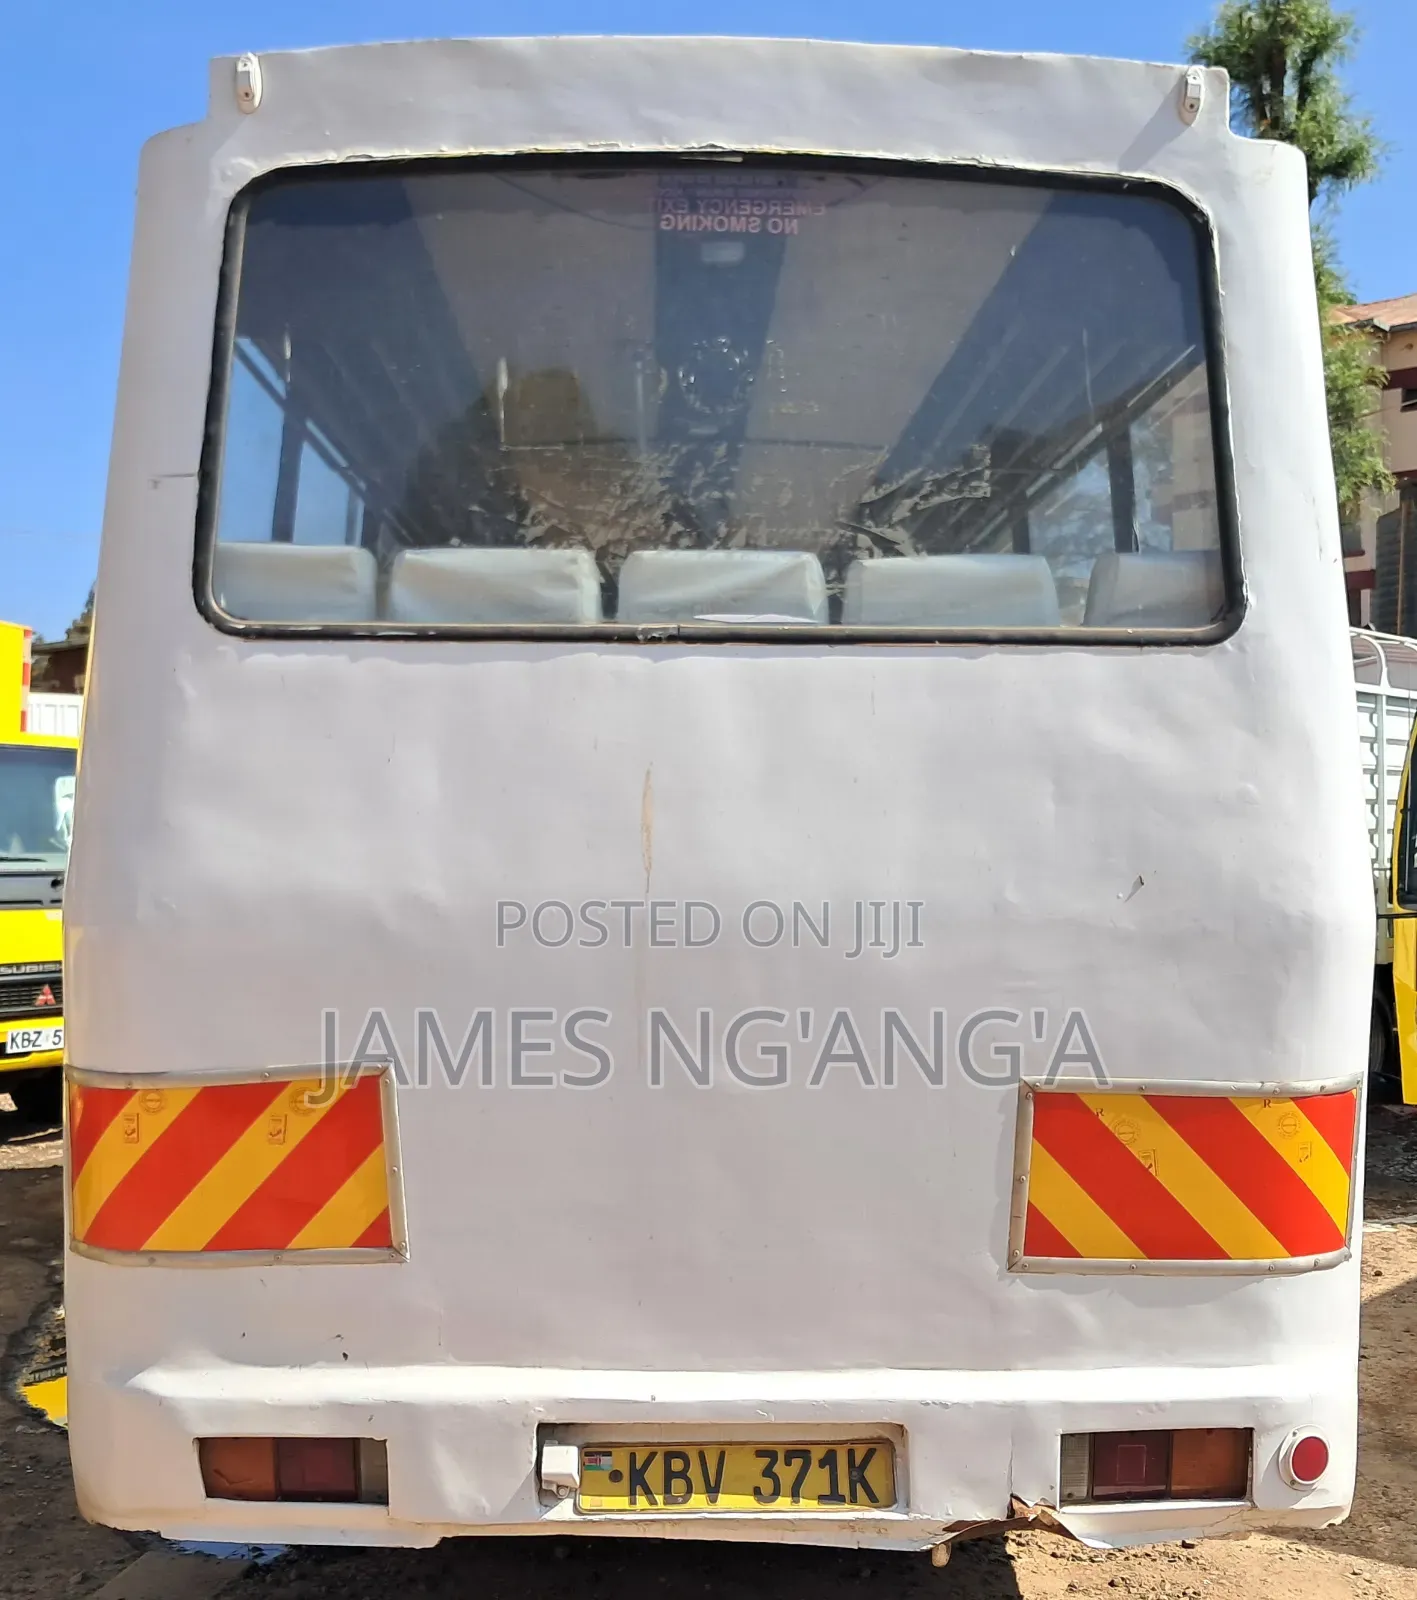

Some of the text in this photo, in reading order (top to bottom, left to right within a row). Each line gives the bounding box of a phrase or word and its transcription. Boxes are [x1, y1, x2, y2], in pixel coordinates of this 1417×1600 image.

[10, 1030, 42, 1050] KBZ
[628, 1447, 880, 1506] KBV 371K
